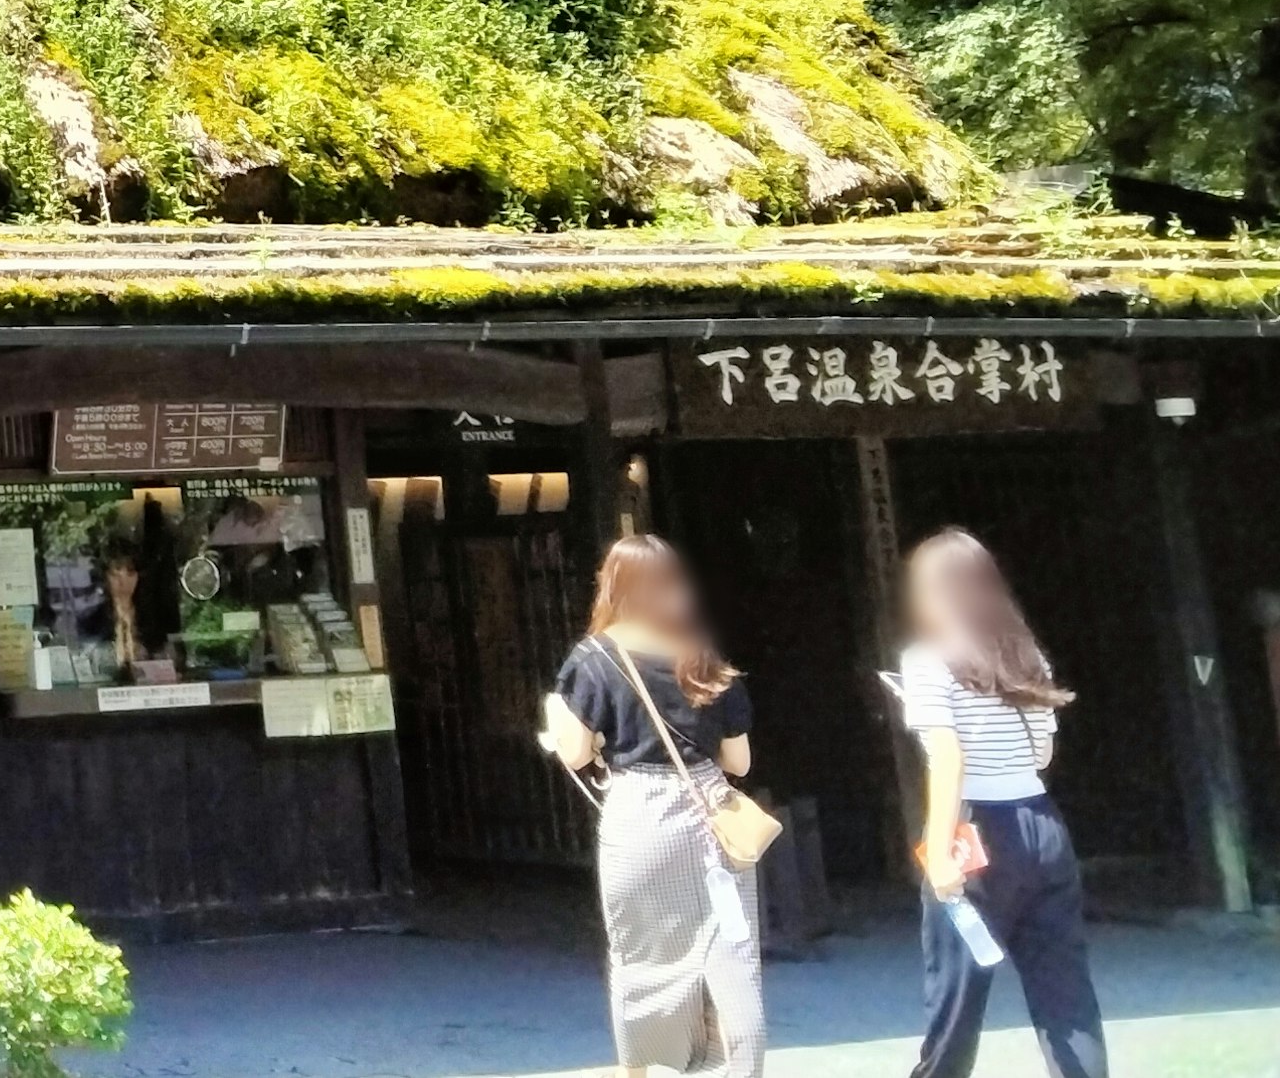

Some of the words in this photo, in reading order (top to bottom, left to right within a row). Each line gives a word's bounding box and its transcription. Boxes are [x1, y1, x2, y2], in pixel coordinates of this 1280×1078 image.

[697, 337, 1064, 407] 下呂温泉合掌村
[461, 430, 515, 441] ENTRANCE
